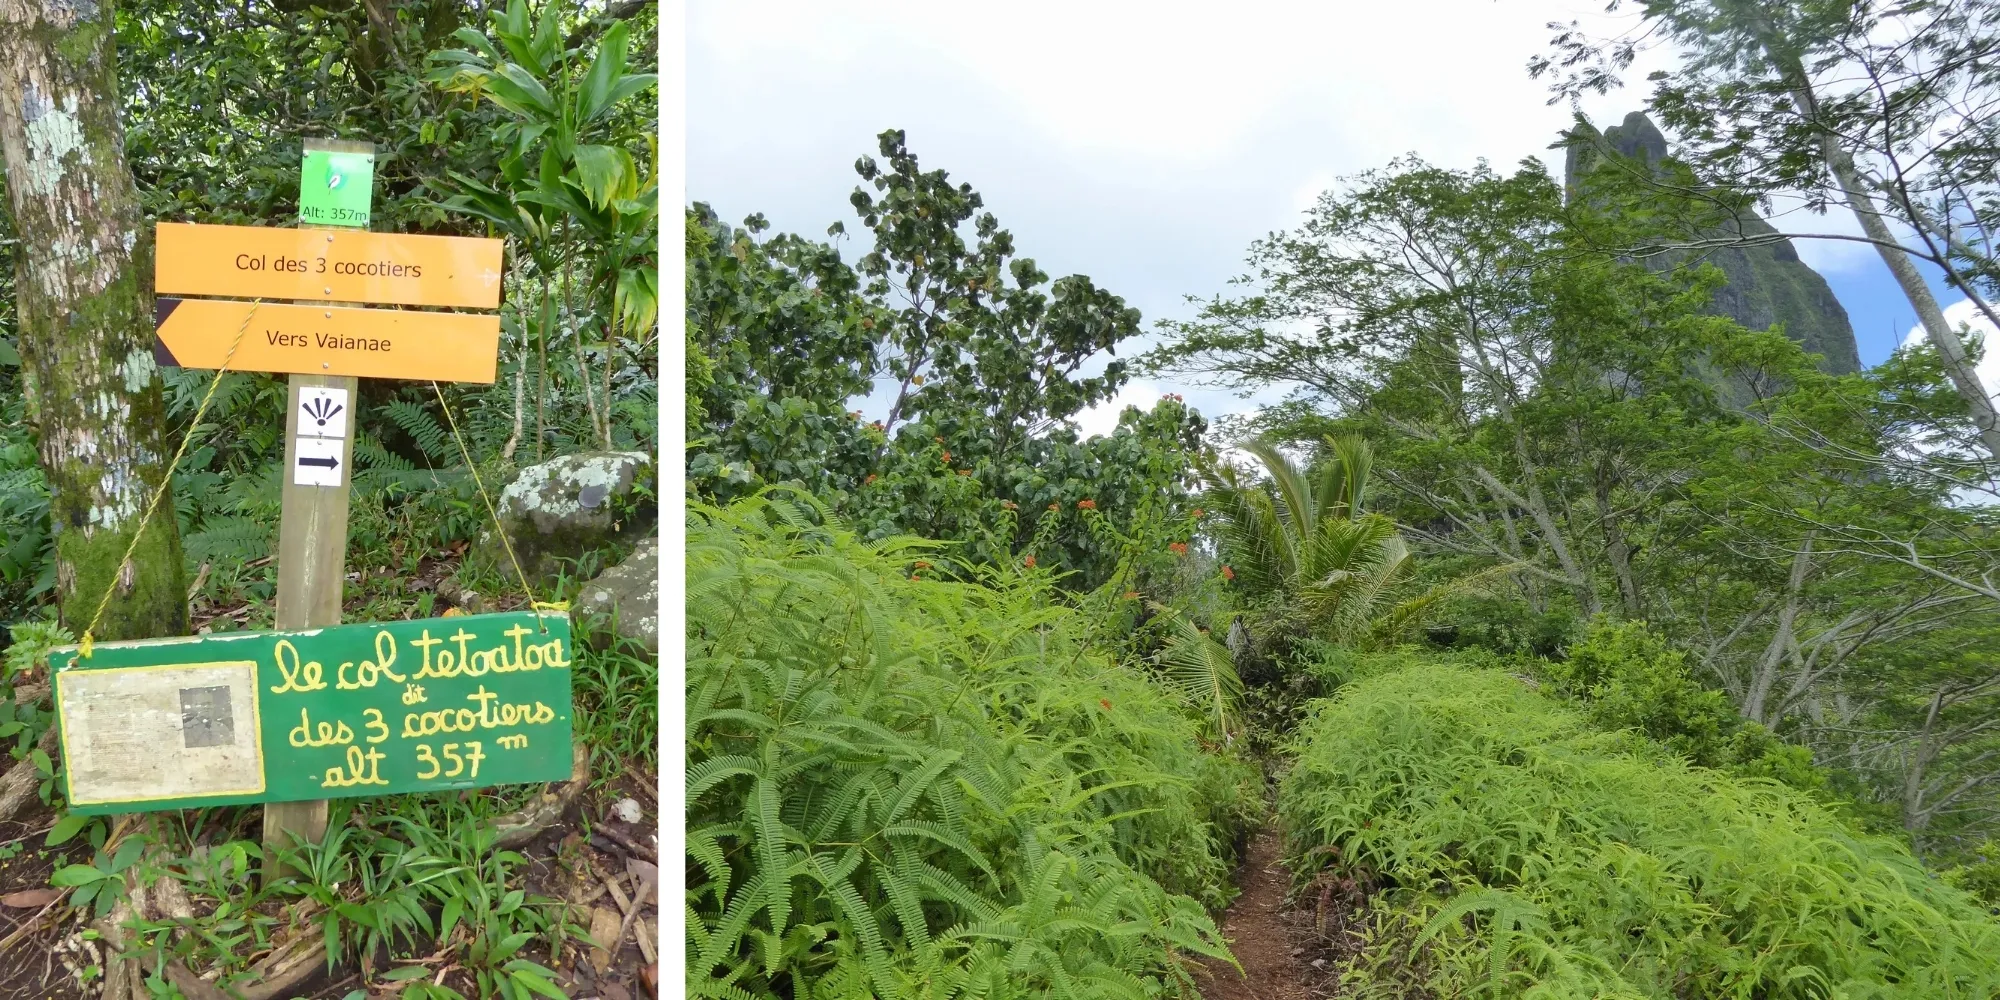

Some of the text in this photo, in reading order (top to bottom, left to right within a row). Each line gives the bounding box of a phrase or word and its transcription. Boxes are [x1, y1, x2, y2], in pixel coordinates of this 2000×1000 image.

[302, 206, 367, 220] Alt: 357m
[236, 254, 422, 278] Col des 3 cocotiers
[266, 330, 391, 351] Vers Vaianae
[271, 623, 571, 693] le col tetoatoa
[402, 683, 427, 705] dit
[289, 708, 354, 747] des
[363, 708, 389, 743] 3
[321, 745, 389, 787] alt
[416, 741, 486, 779] 357
